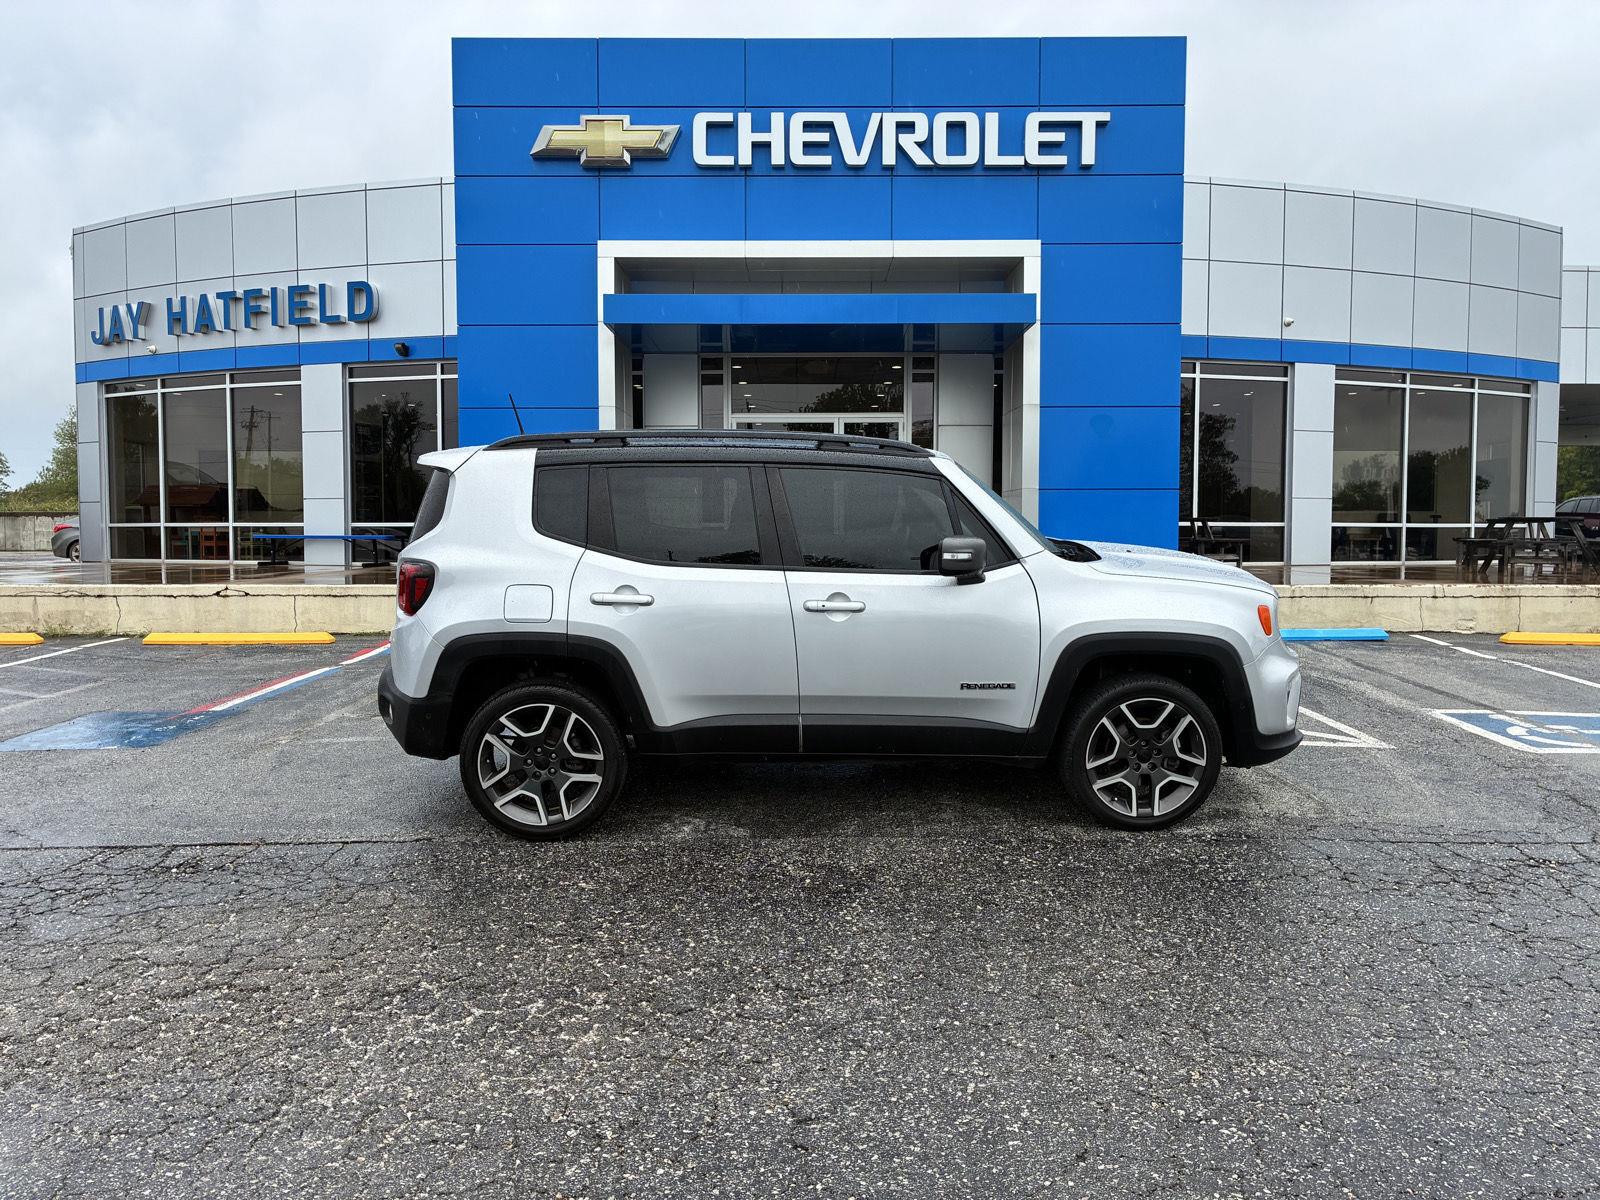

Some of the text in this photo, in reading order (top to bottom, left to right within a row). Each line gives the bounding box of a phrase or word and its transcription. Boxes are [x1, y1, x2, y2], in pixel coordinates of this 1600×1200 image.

[692, 111, 1111, 167] CHEVROLET
[91, 280, 377, 346] JAY HATFIELD
[960, 682, 1016, 690] RENEGADE
